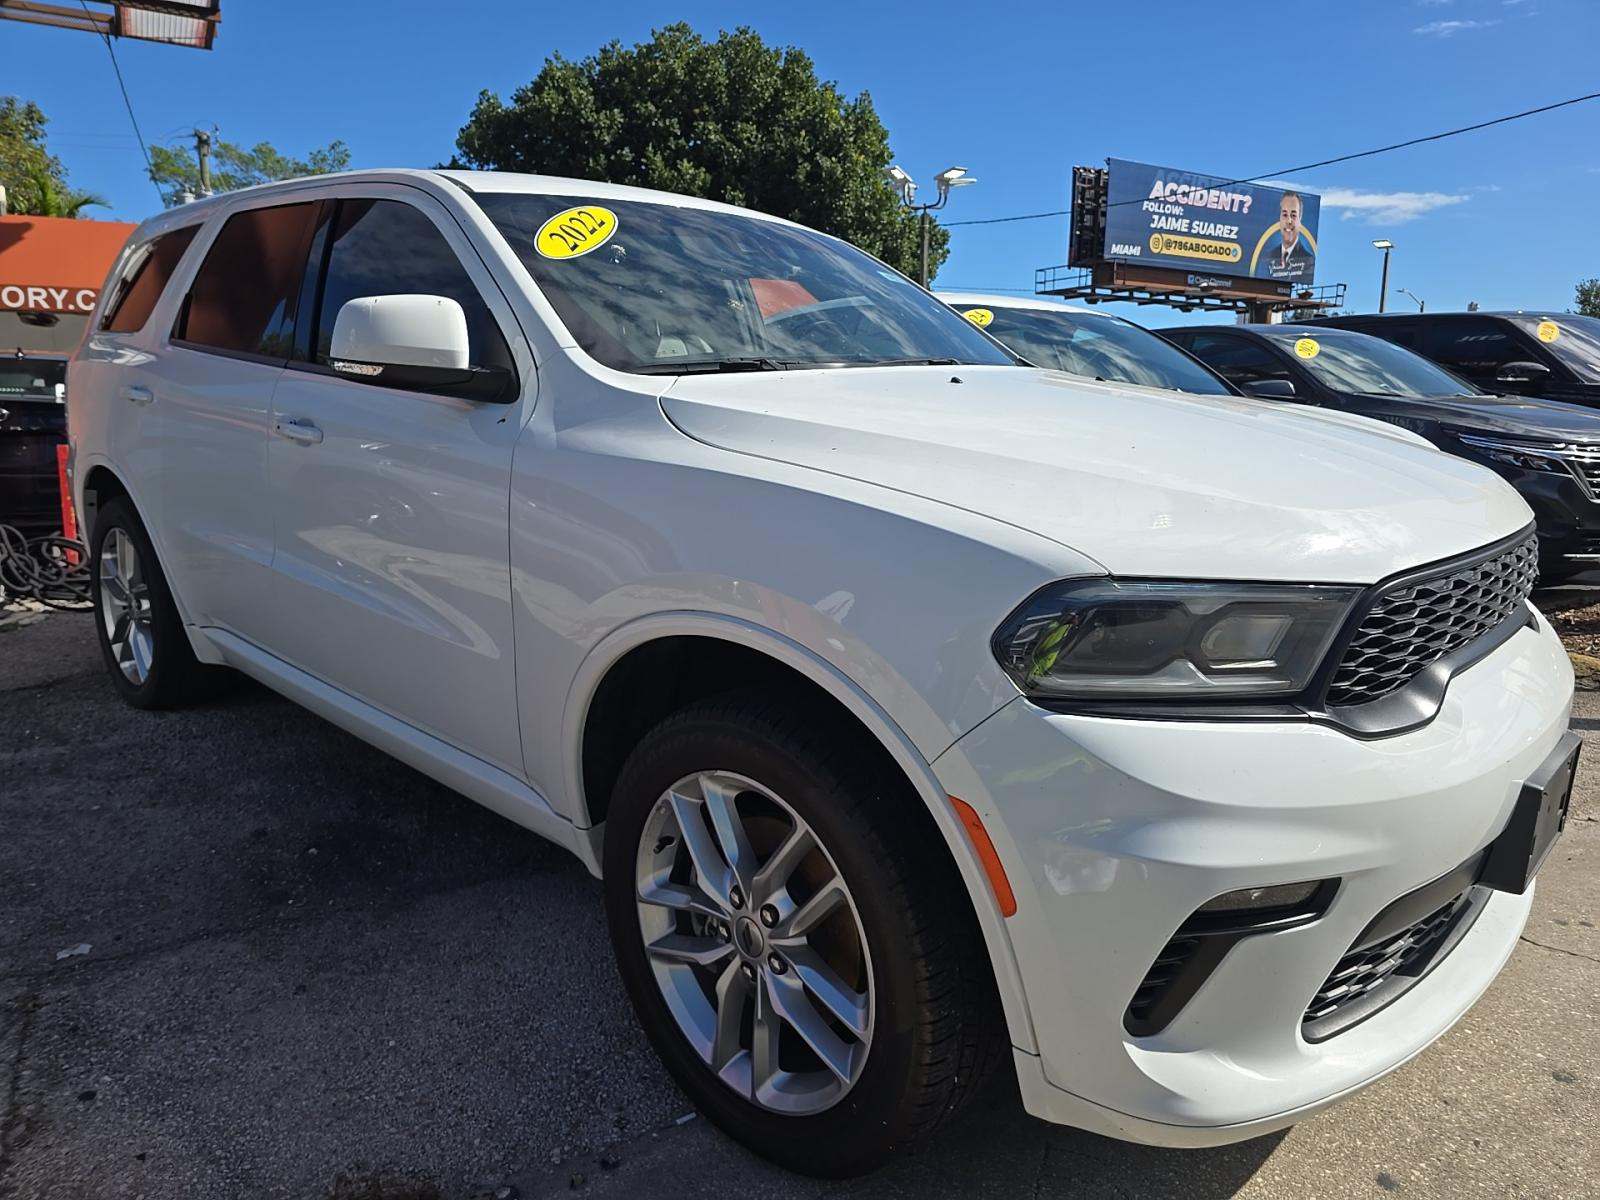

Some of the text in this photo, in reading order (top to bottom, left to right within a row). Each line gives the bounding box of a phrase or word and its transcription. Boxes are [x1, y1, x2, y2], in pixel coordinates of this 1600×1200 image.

[1149, 180, 1253, 214] ACCIDENT?
[1142, 200, 1184, 216] FOLLOW:
[549, 210, 606, 252] 2022
[1150, 214, 1240, 239] JAIME SUAREZ
[1110, 243, 1142, 256] MIAMI
[1164, 239, 1231, 257] @786ABOGADO
